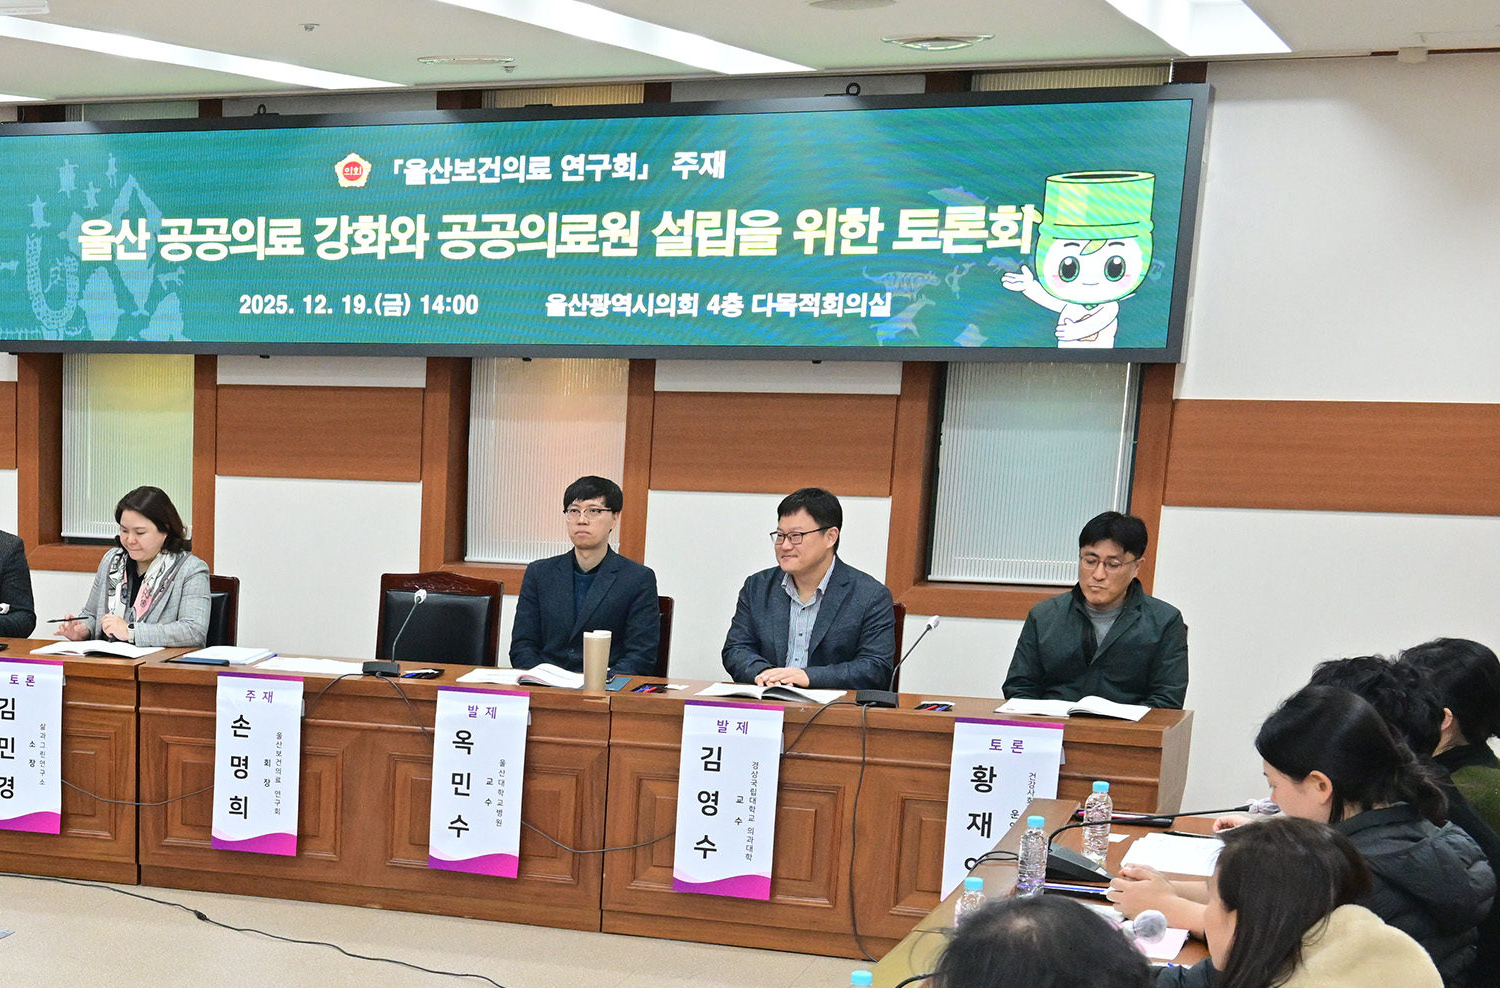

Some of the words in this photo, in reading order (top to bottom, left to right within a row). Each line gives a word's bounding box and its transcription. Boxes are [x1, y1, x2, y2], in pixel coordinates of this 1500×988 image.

[344, 166, 363, 178] 의회
[671, 150, 727, 180] 주재
[77, 218, 152, 262] 울산
[157, 216, 305, 262] 공공의료
[313, 213, 430, 261] 강화와
[437, 210, 641, 260] 공공의료원
[651, 209, 783, 258] 설립을
[792, 206, 885, 257] 위한
[892, 204, 1035, 255] 토론회
[238, 294, 295, 315] 2025.
[302, 294, 334, 315] 12.
[341, 292, 411, 317] 19.(금)
[420, 293, 480, 316] 14:00
[545, 292, 699, 318] 울산광역시의회
[706, 292, 745, 318] 4층
[750, 291, 893, 318] 다목적회의실
[9, 674, 36, 688] 토론
[245, 689, 274, 704] 주재
[467, 704, 498, 720] 발제
[716, 719, 749, 735] 발제
[28, 740, 37, 768] 소장
[275, 731, 283, 784] 울산보건의료
[988, 738, 1025, 755] 토론
[228, 714, 252, 820] 손명희
[263, 758, 272, 788] 회장
[448, 729, 475, 839] 옥민수
[484, 777, 494, 807] 교수
[496, 758, 506, 828] 울산대학교병원
[747, 761, 759, 823] 경상국립대학교
[274, 789, 282, 816] 연구회
[693, 746, 723, 860] 김영수
[734, 794, 744, 826] 교수
[745, 826, 755, 862] 의과대학
